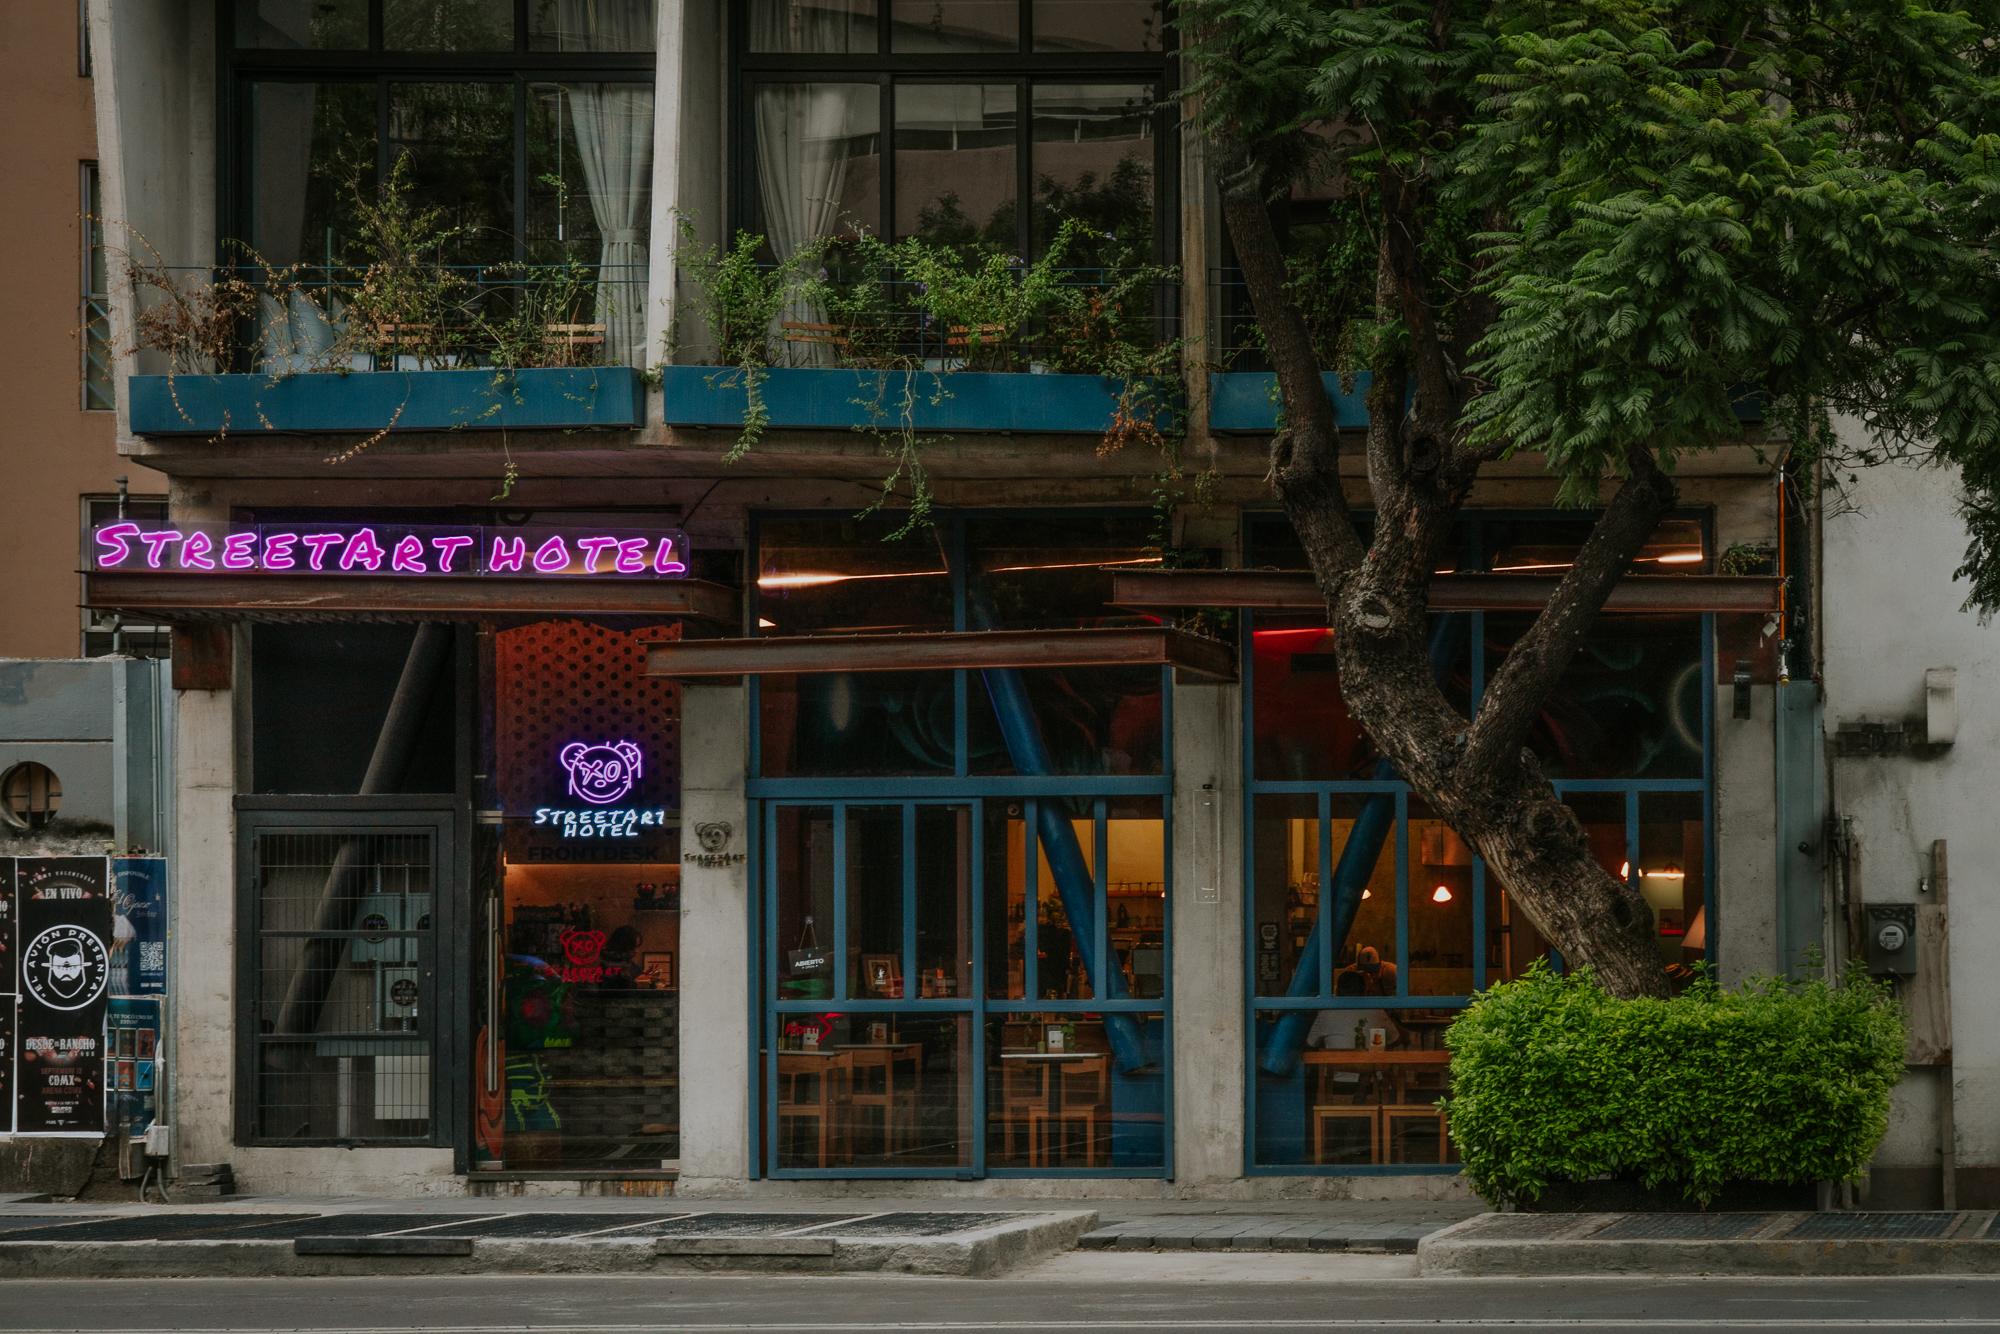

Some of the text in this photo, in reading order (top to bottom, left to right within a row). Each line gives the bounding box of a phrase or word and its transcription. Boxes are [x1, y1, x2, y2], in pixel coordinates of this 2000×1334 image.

[96, 523, 686, 575] STREETART HOTEL
[534, 807, 665, 826] STREETART
[563, 822, 639, 838] HOTEL
[528, 846, 658, 861] FRONT DESK
[683, 852, 746, 864] STREETART
[697, 858, 732, 867] HOTEL
[44, 887, 83, 899] EN VIVO
[794, 958, 824, 967] ABIERTO
[25, 1038, 54, 1050] DESDE
[59, 1038, 96, 1050] RANCHO
[48, 1074, 75, 1086] CDMX
